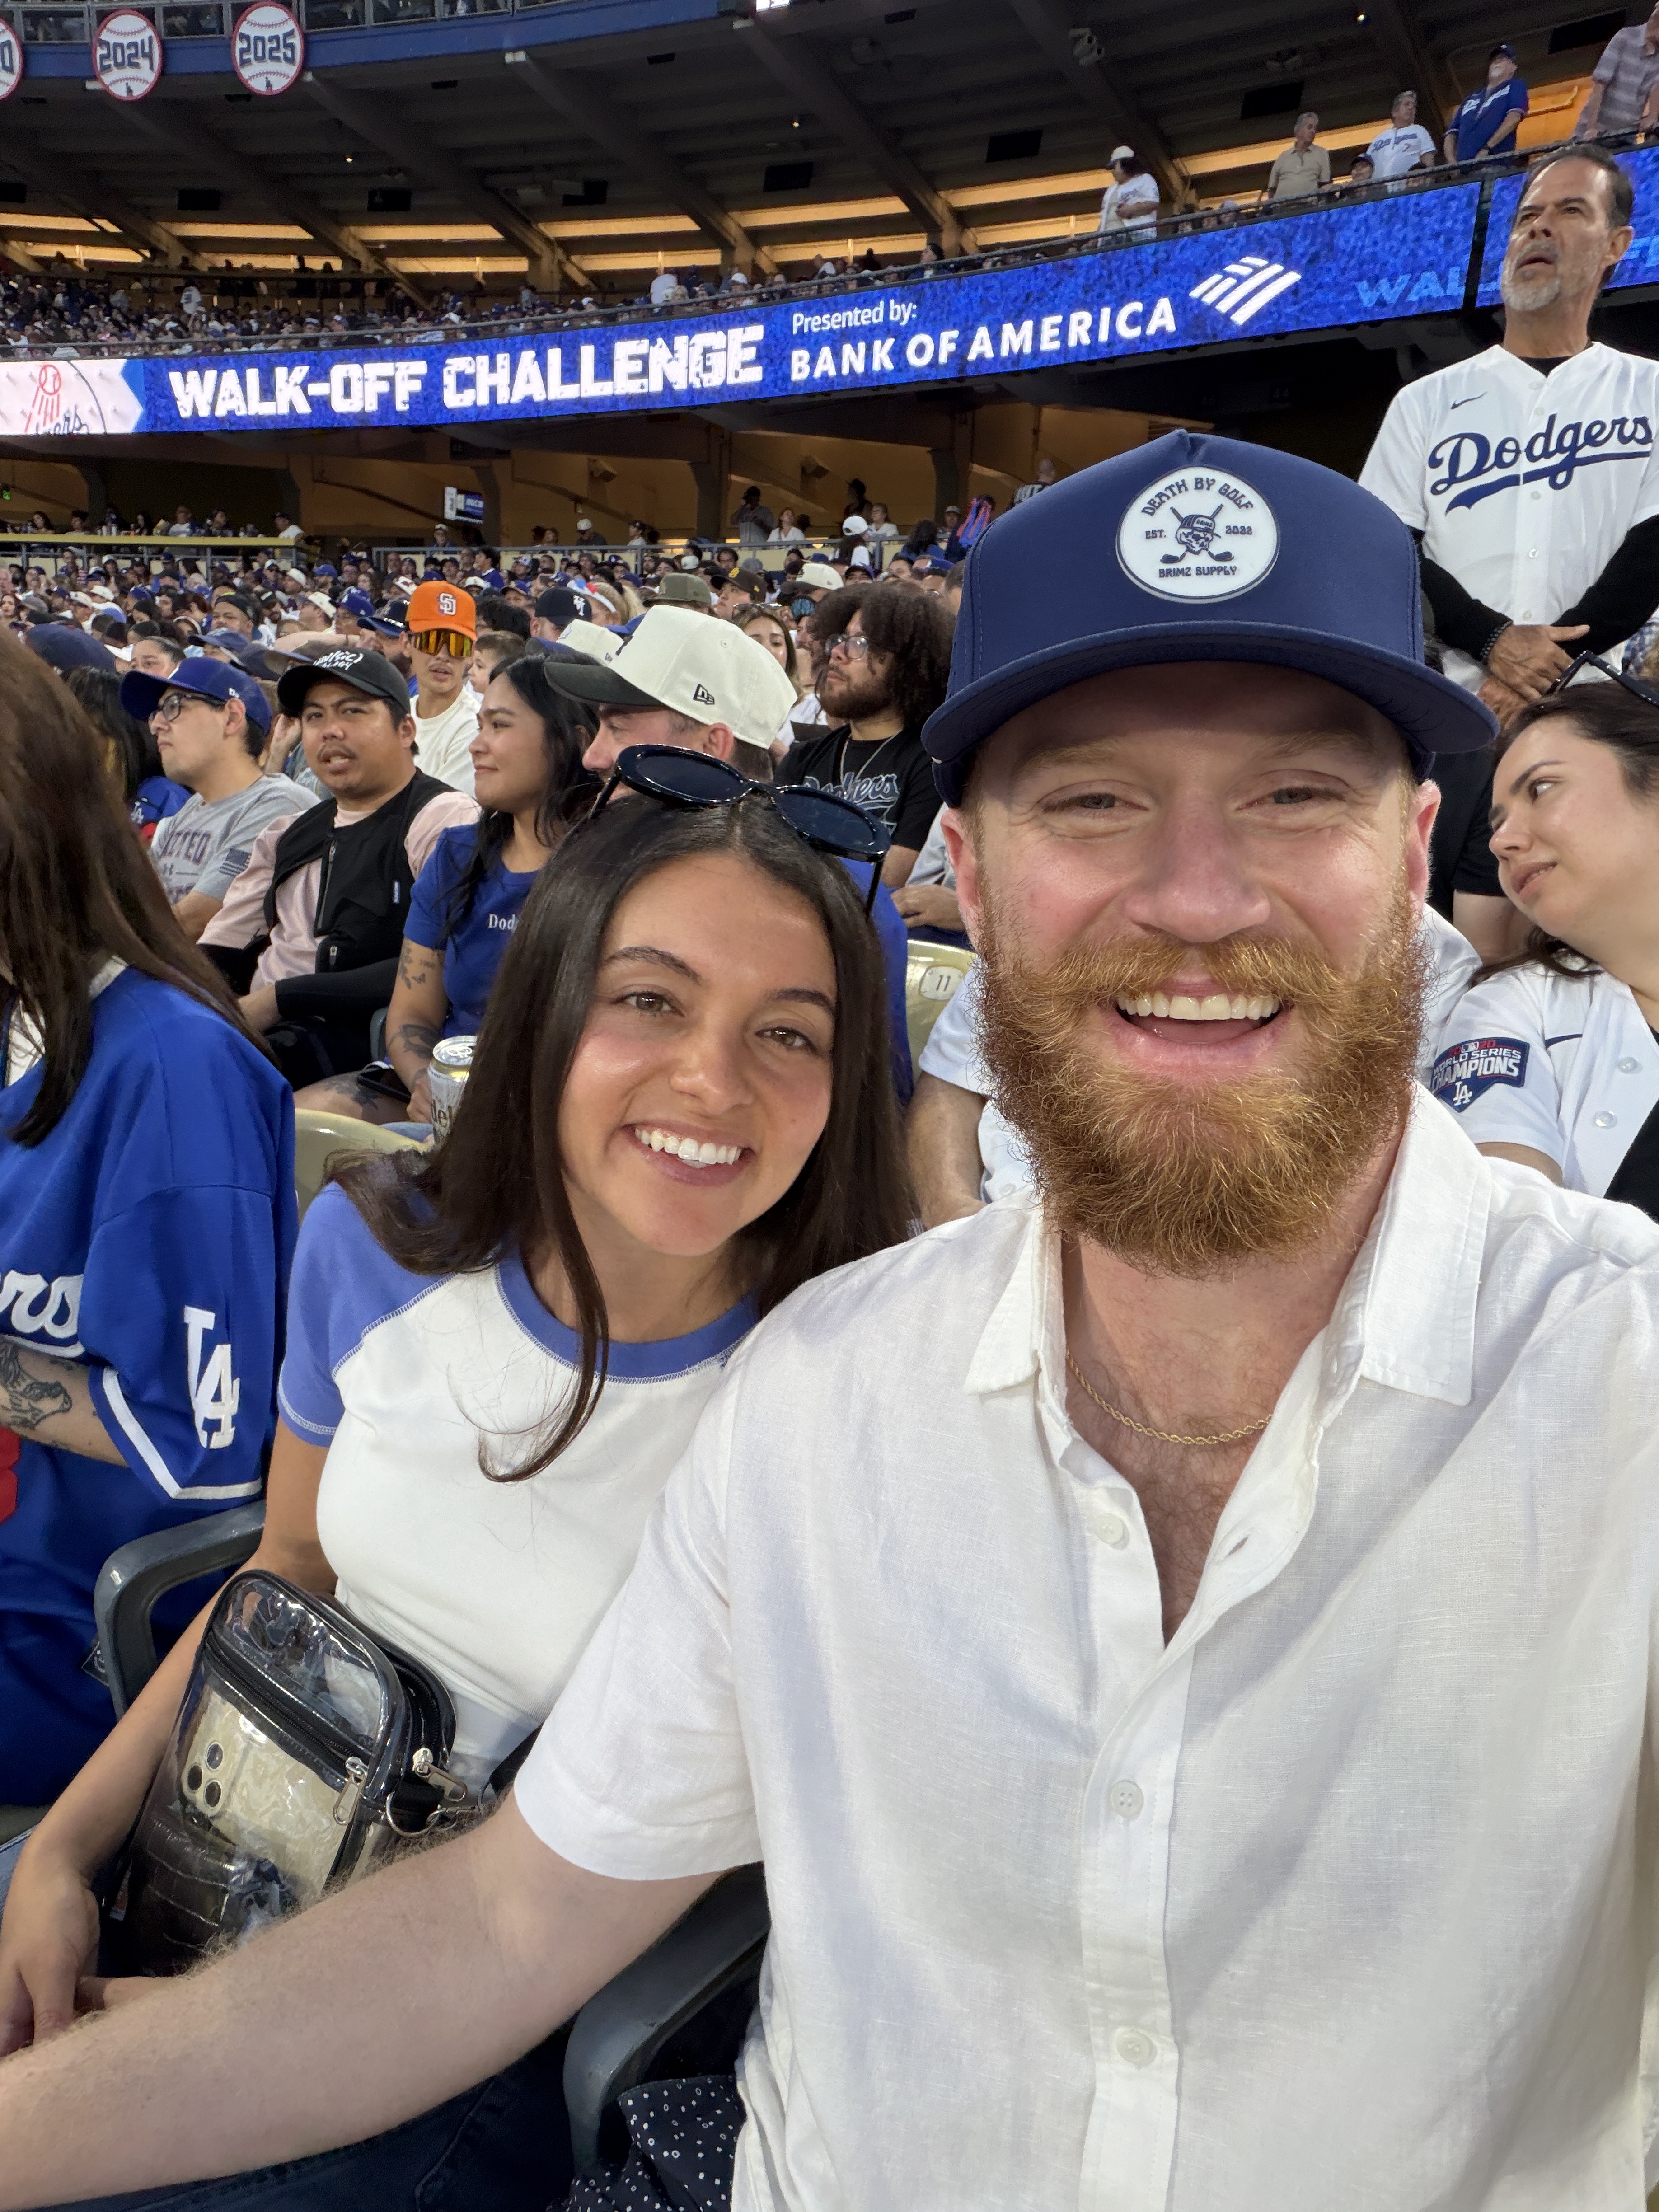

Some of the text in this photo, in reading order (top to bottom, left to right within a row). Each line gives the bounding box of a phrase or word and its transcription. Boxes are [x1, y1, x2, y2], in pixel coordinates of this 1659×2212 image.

[98, 35, 154, 72] 2024
[238, 29, 295, 66] 2025
[792, 298, 917, 335] Presented by:
[790, 297, 1176, 382] BANK OF AMERICA
[168, 361, 428, 418] WALK-OFF
[443, 325, 764, 408] CHALLENGE
[1428, 413, 1654, 496] Dodgers
[1141, 477, 1253, 516] DEATH BY GOLF
[1145, 529, 1167, 539] EST.
[1158, 566, 1237, 578] BRIMZ SUPPLY
[936, 974, 950, 991] 11
[1432, 1056, 1520, 1093] CHAMPIONS
[1434, 1047, 1522, 1076] WORLD SERIES
[1453, 1081, 1473, 1106] LA
[0, 1269, 85, 1339] rs
[183, 1305, 240, 1449] LA
